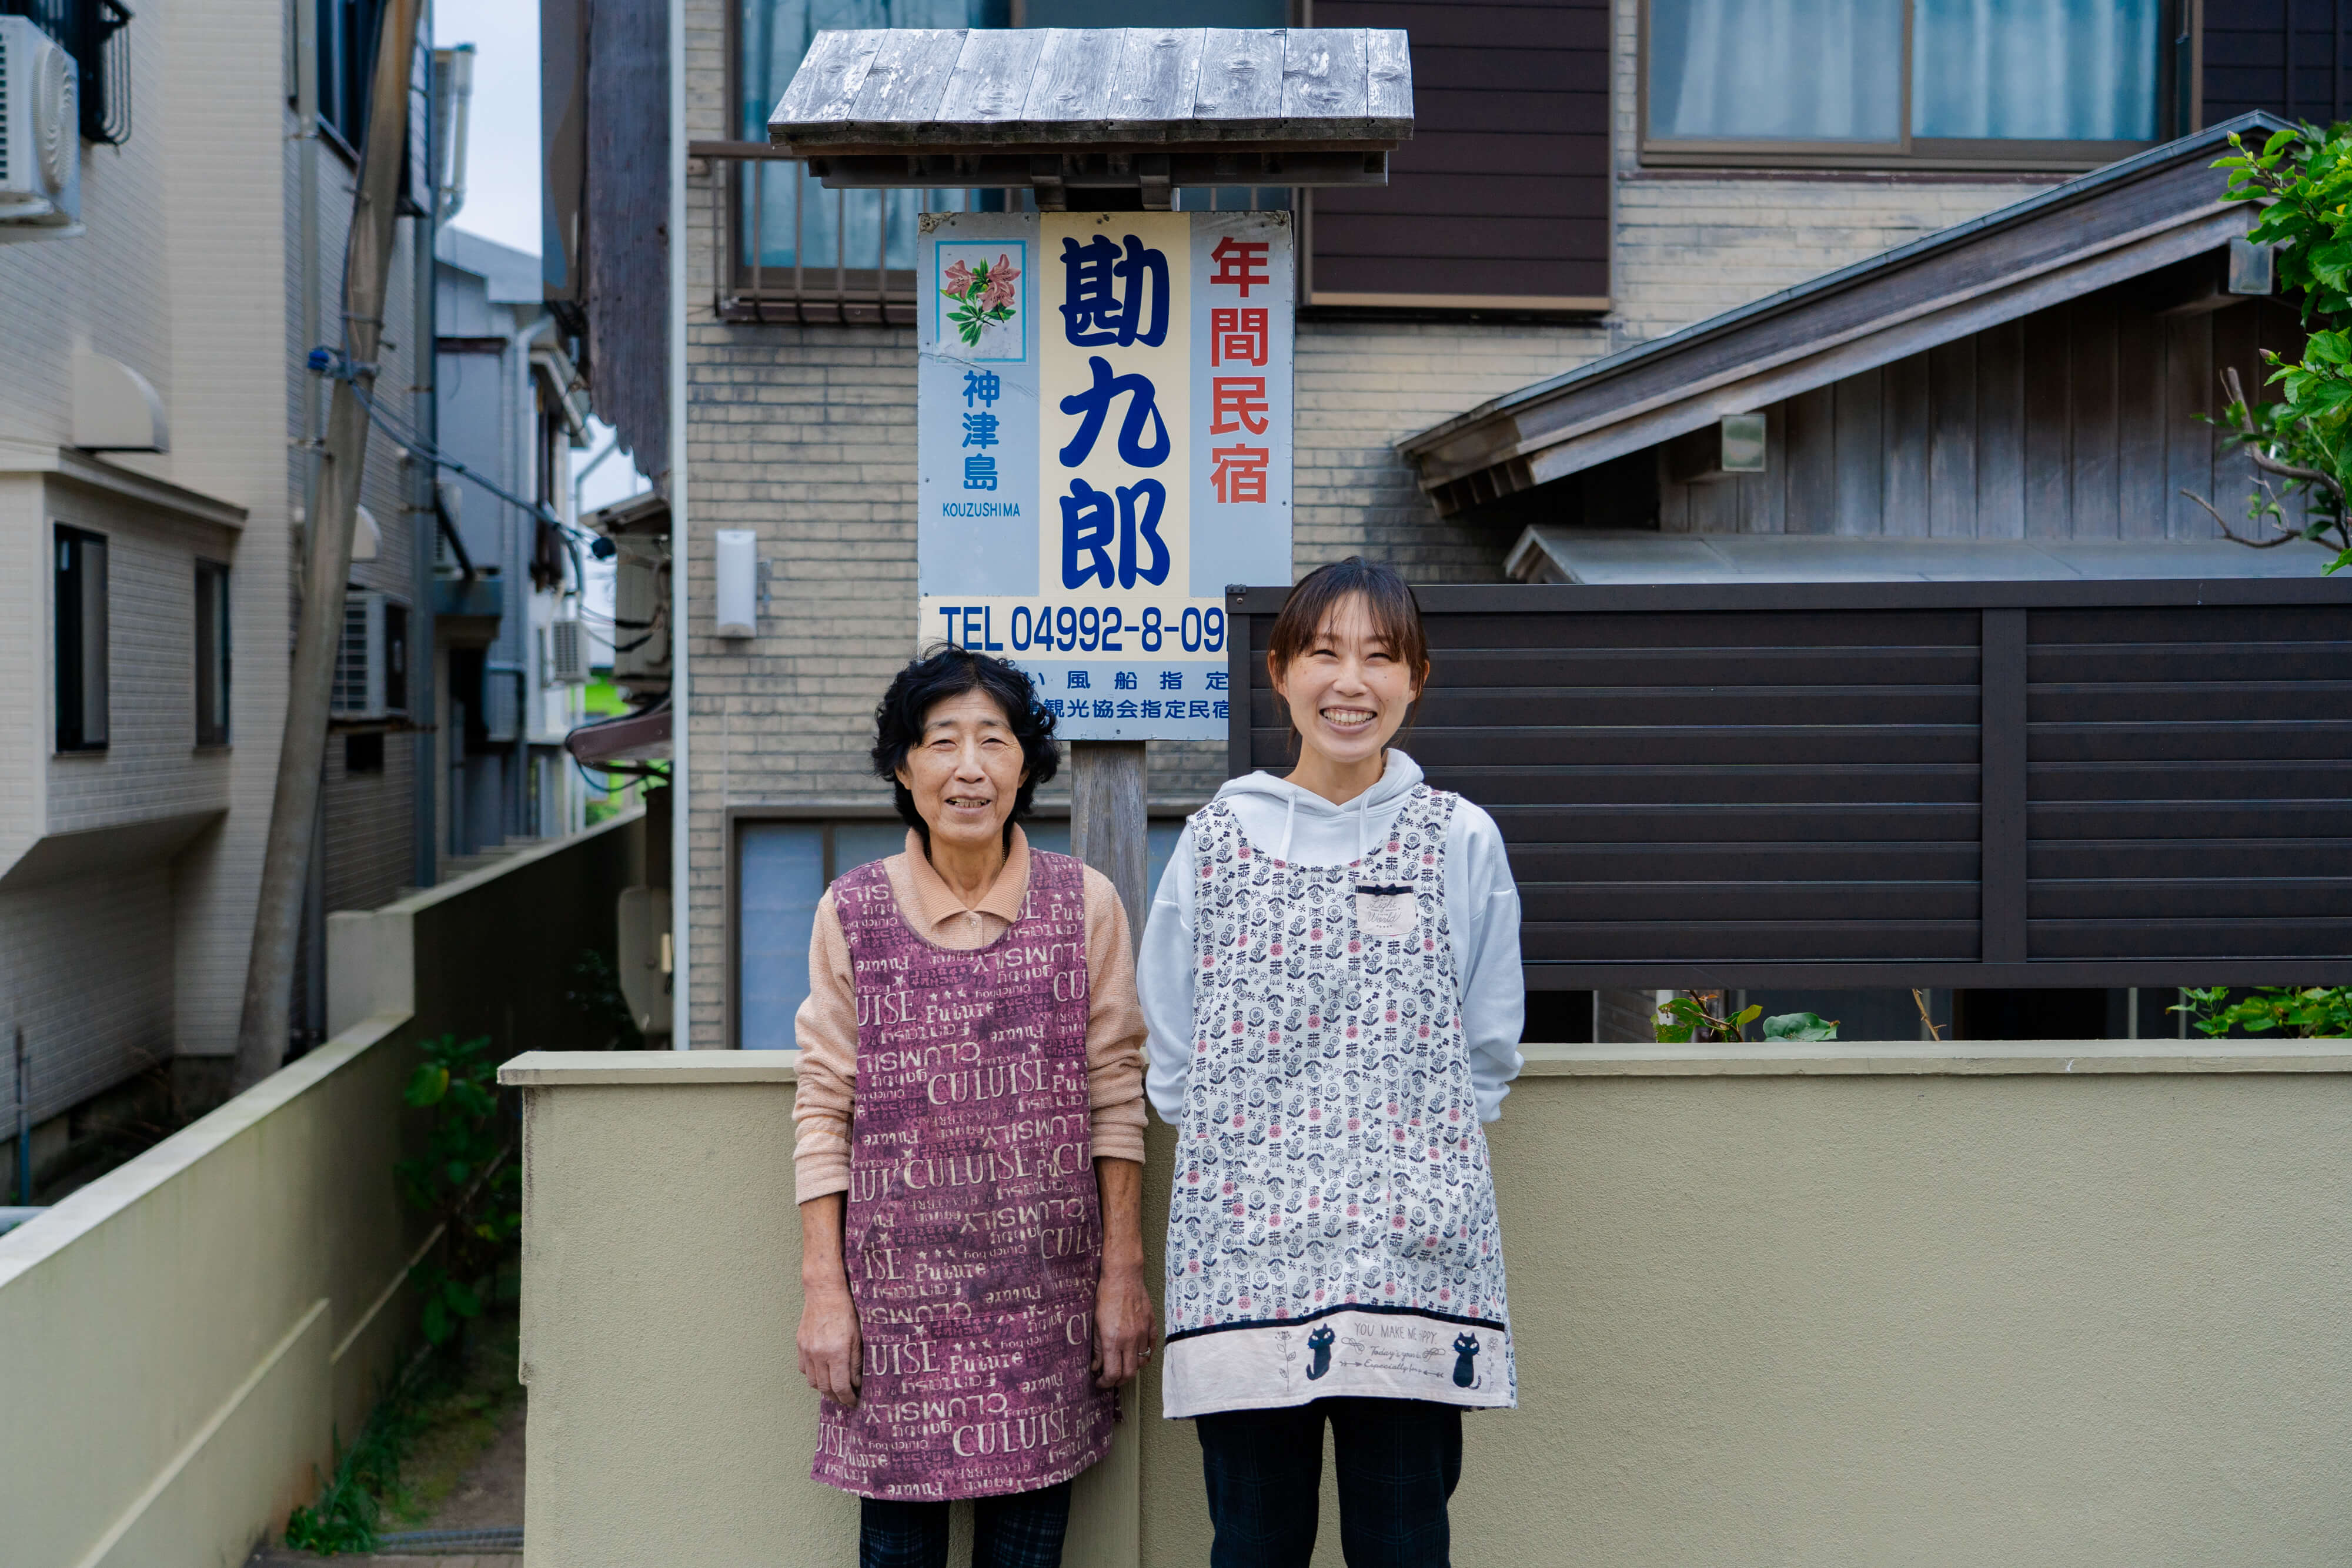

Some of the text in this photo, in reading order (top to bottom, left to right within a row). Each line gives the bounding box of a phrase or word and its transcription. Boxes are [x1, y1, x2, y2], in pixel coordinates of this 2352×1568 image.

[1209, 236, 1269, 504] 年間民宿
[962, 369, 1001, 492] 神津島
[1059, 234, 1171, 590] 勘九郎
[942, 502, 1021, 517] KOUZUSHIMA
[939, 606, 1228, 652] TEL 04992-8-09
[1368, 912, 1402, 923] World
[1354, 1323, 1375, 1337] YOU
[1381, 1324, 1405, 1340] MAKE
